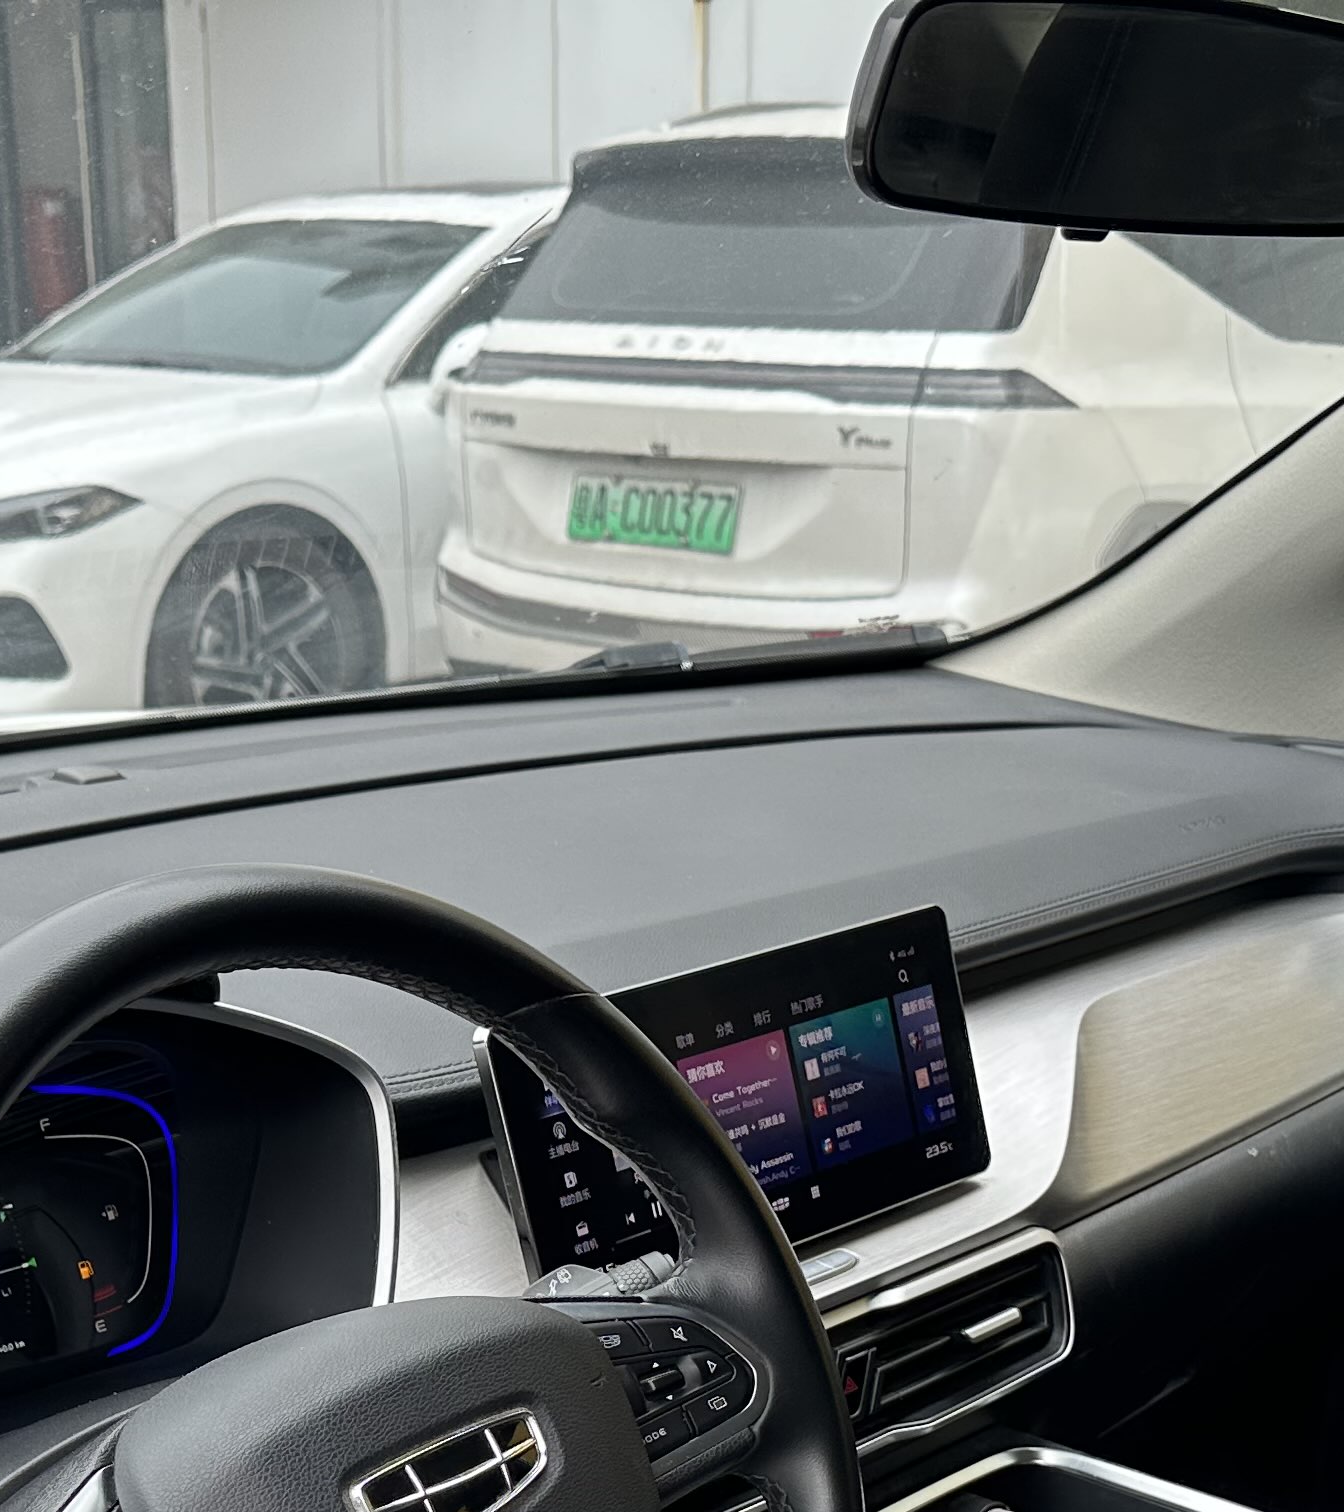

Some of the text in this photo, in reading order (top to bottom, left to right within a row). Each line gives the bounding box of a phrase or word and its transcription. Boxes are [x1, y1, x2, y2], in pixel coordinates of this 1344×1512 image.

[715, 1021, 734, 1038] 分类
[712, 1090, 734, 1104] Come
[39, 1117, 51, 1133] F
[761, 1152, 794, 1170] Assassin
[94, 1320, 108, 1335] E
[641, 1427, 667, 1445] ODE
